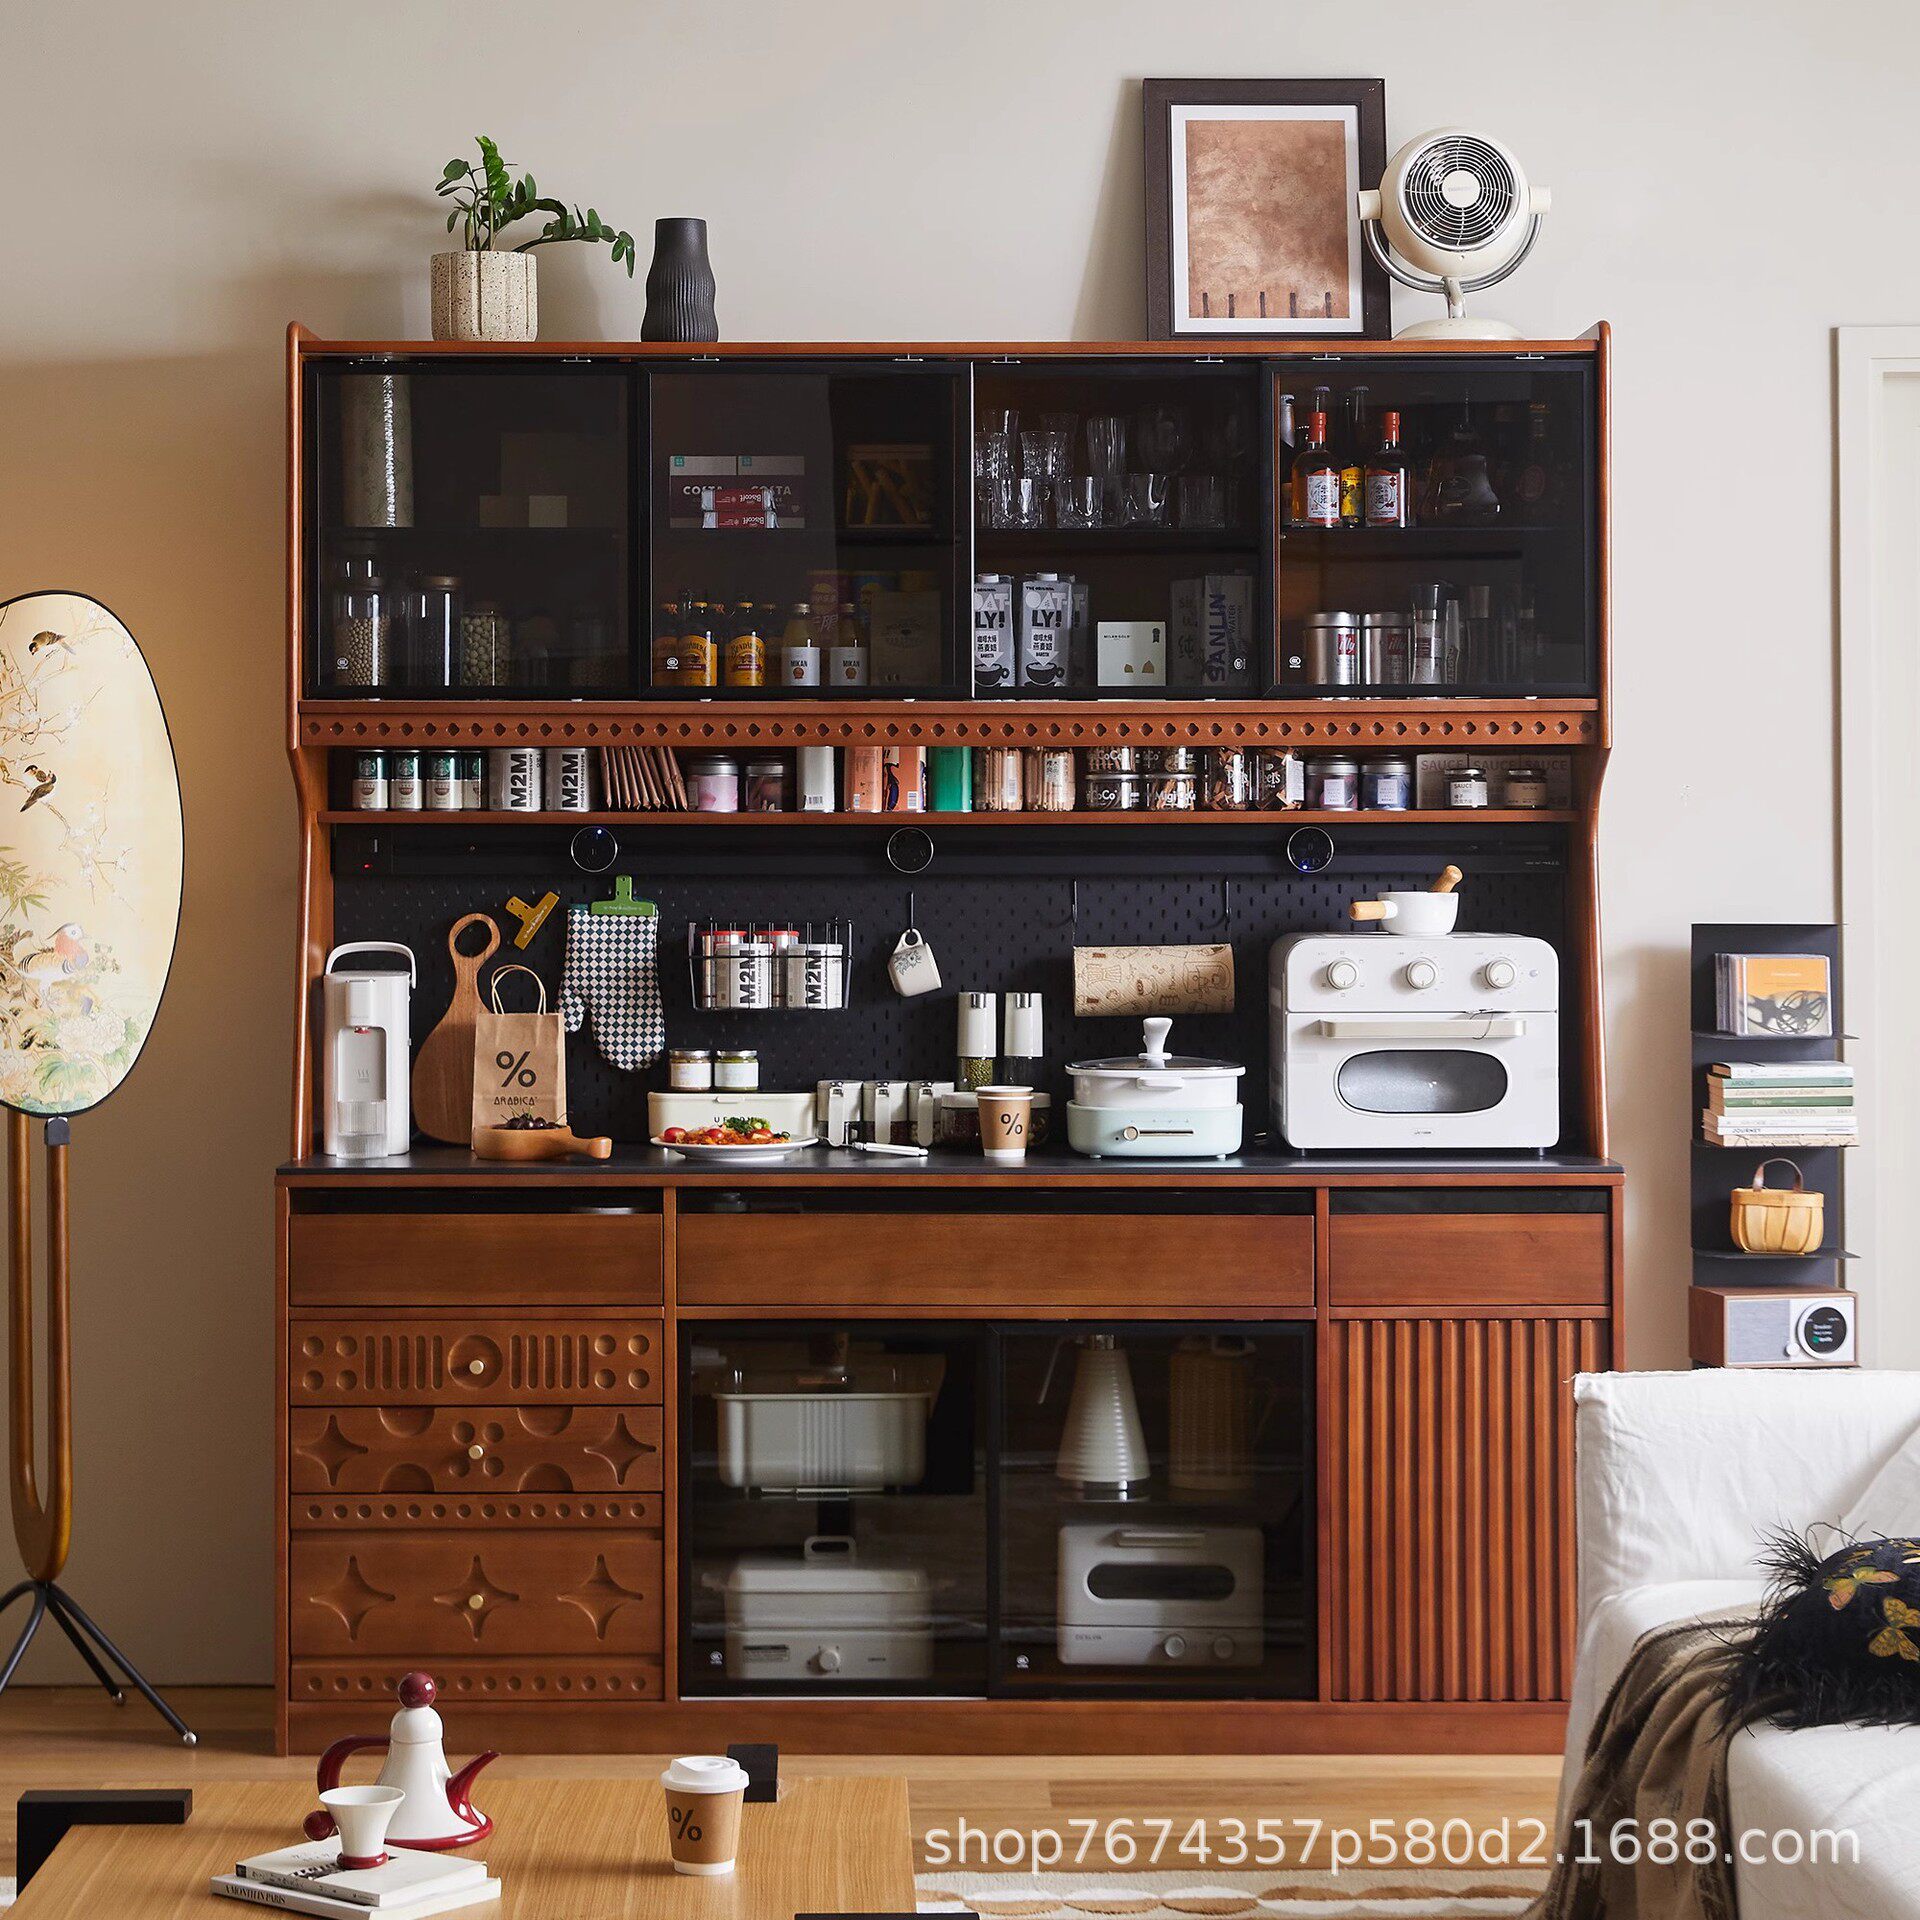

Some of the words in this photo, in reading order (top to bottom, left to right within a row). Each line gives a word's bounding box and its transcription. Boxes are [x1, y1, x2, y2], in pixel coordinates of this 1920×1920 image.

[975, 610, 1005, 629] LY!
[1032, 609, 1062, 628] LY!
[1420, 760, 1464, 771] SAUCE
[1473, 760, 1516, 770] SAUCE
[1525, 760, 1569, 770] SAUCE
[510, 753, 527, 807] M2M
[561, 753, 578, 808] M2M
[739, 949, 756, 1004] M2M
[806, 949, 822, 1004] M2M
[493, 1096, 535, 1105] ARABICA
[266, 1893, 286, 1904] PARIS
